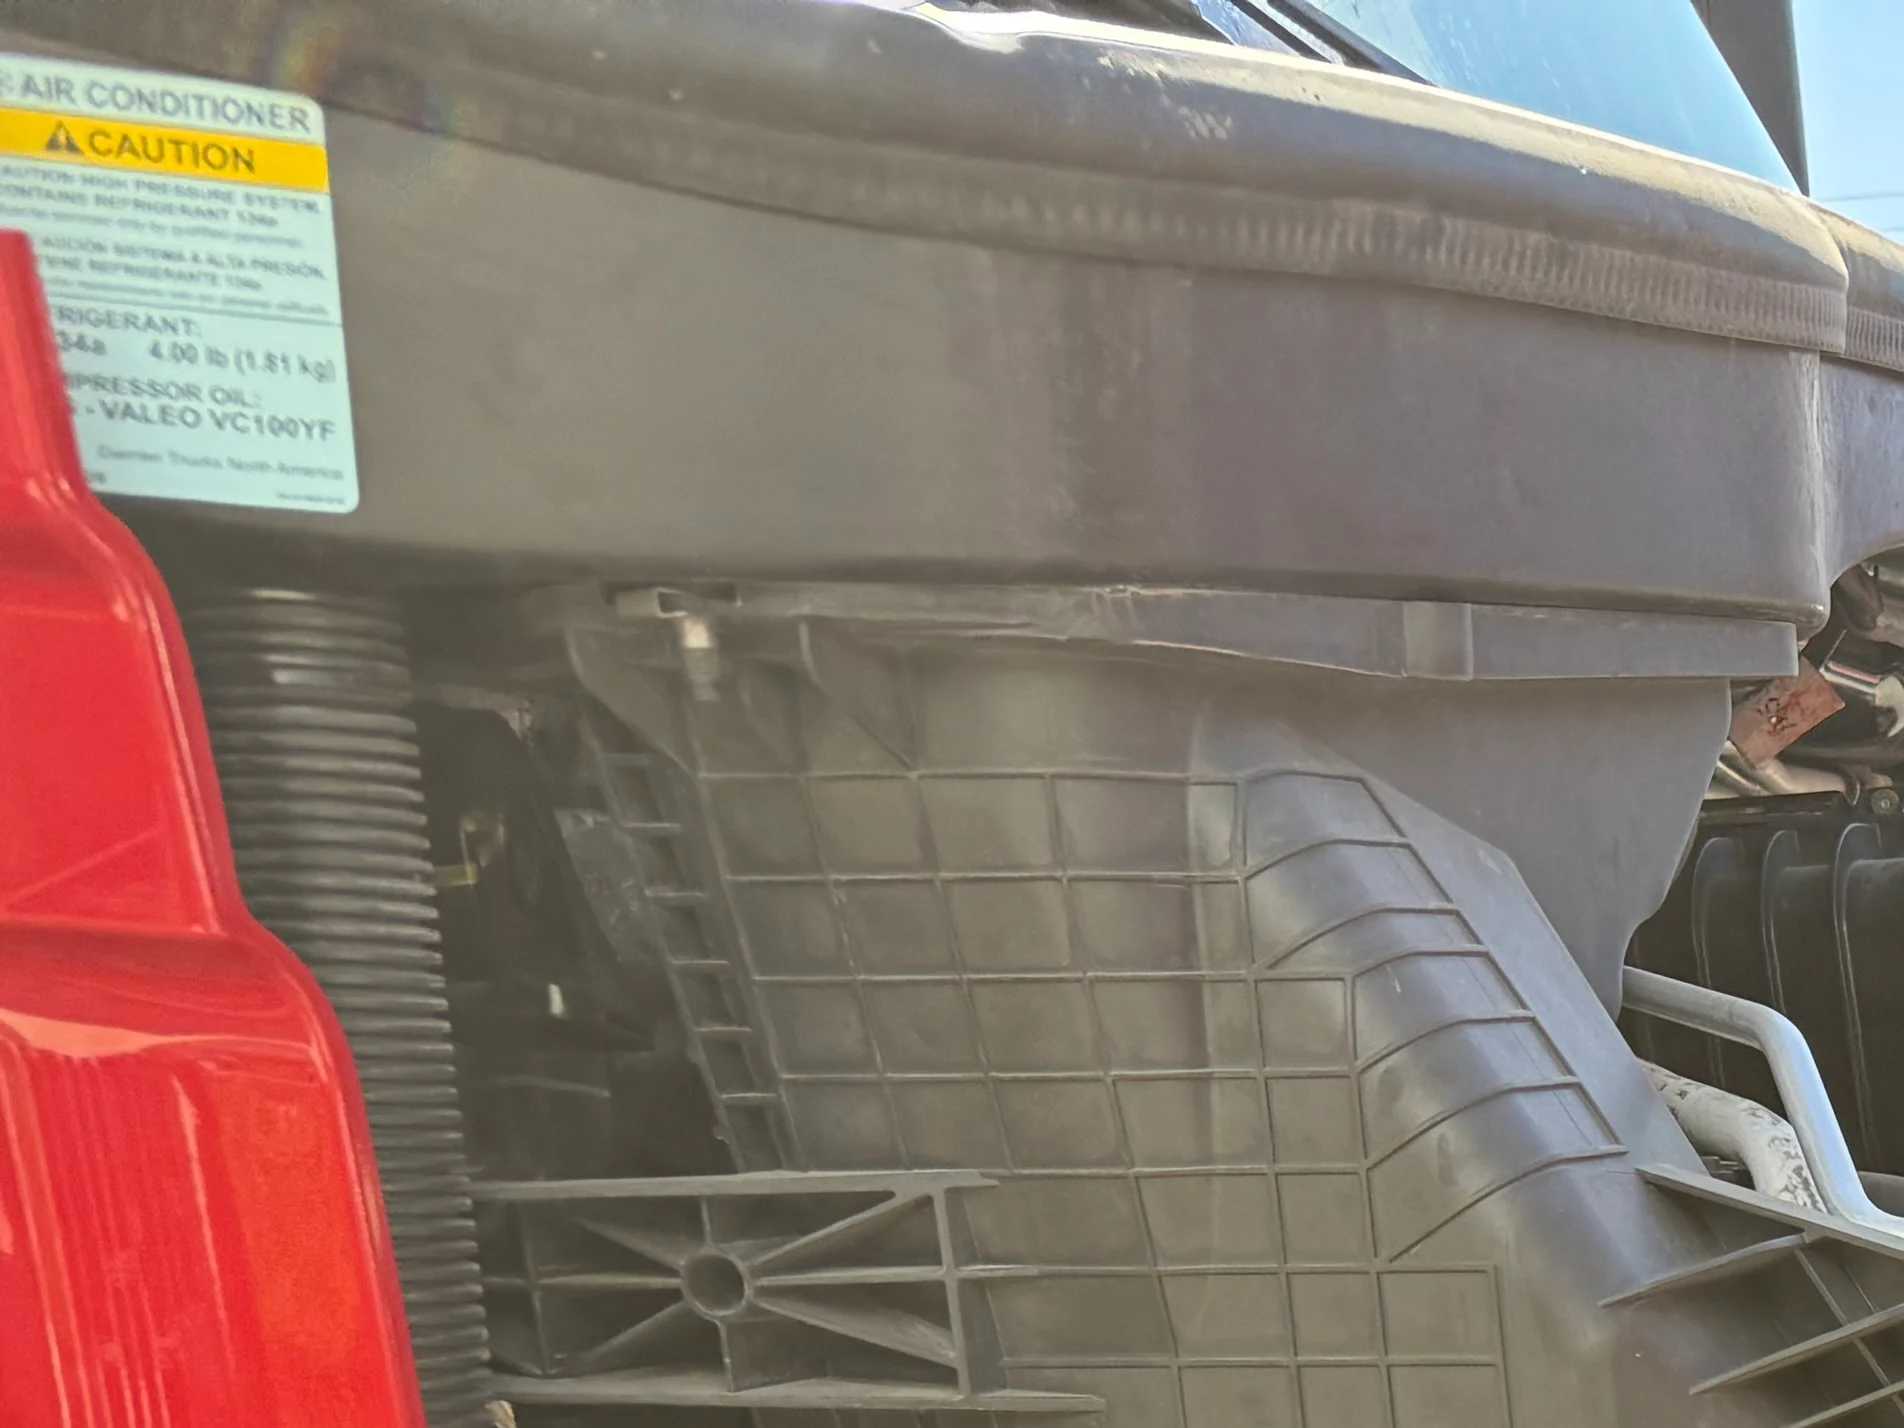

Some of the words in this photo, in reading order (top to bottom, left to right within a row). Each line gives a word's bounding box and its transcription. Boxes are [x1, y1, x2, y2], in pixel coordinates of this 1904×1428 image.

[19, 72, 78, 107] AIR
[85, 79, 313, 136] CONDITIONER
[88, 128, 256, 174] CAUTION
[94, 191, 229, 221] REFRIGERANT
[135, 179, 236, 206] PRESSURE
[204, 344, 229, 369] lb
[97, 398, 201, 429] VALEO
[205, 406, 337, 442] VC100YF
